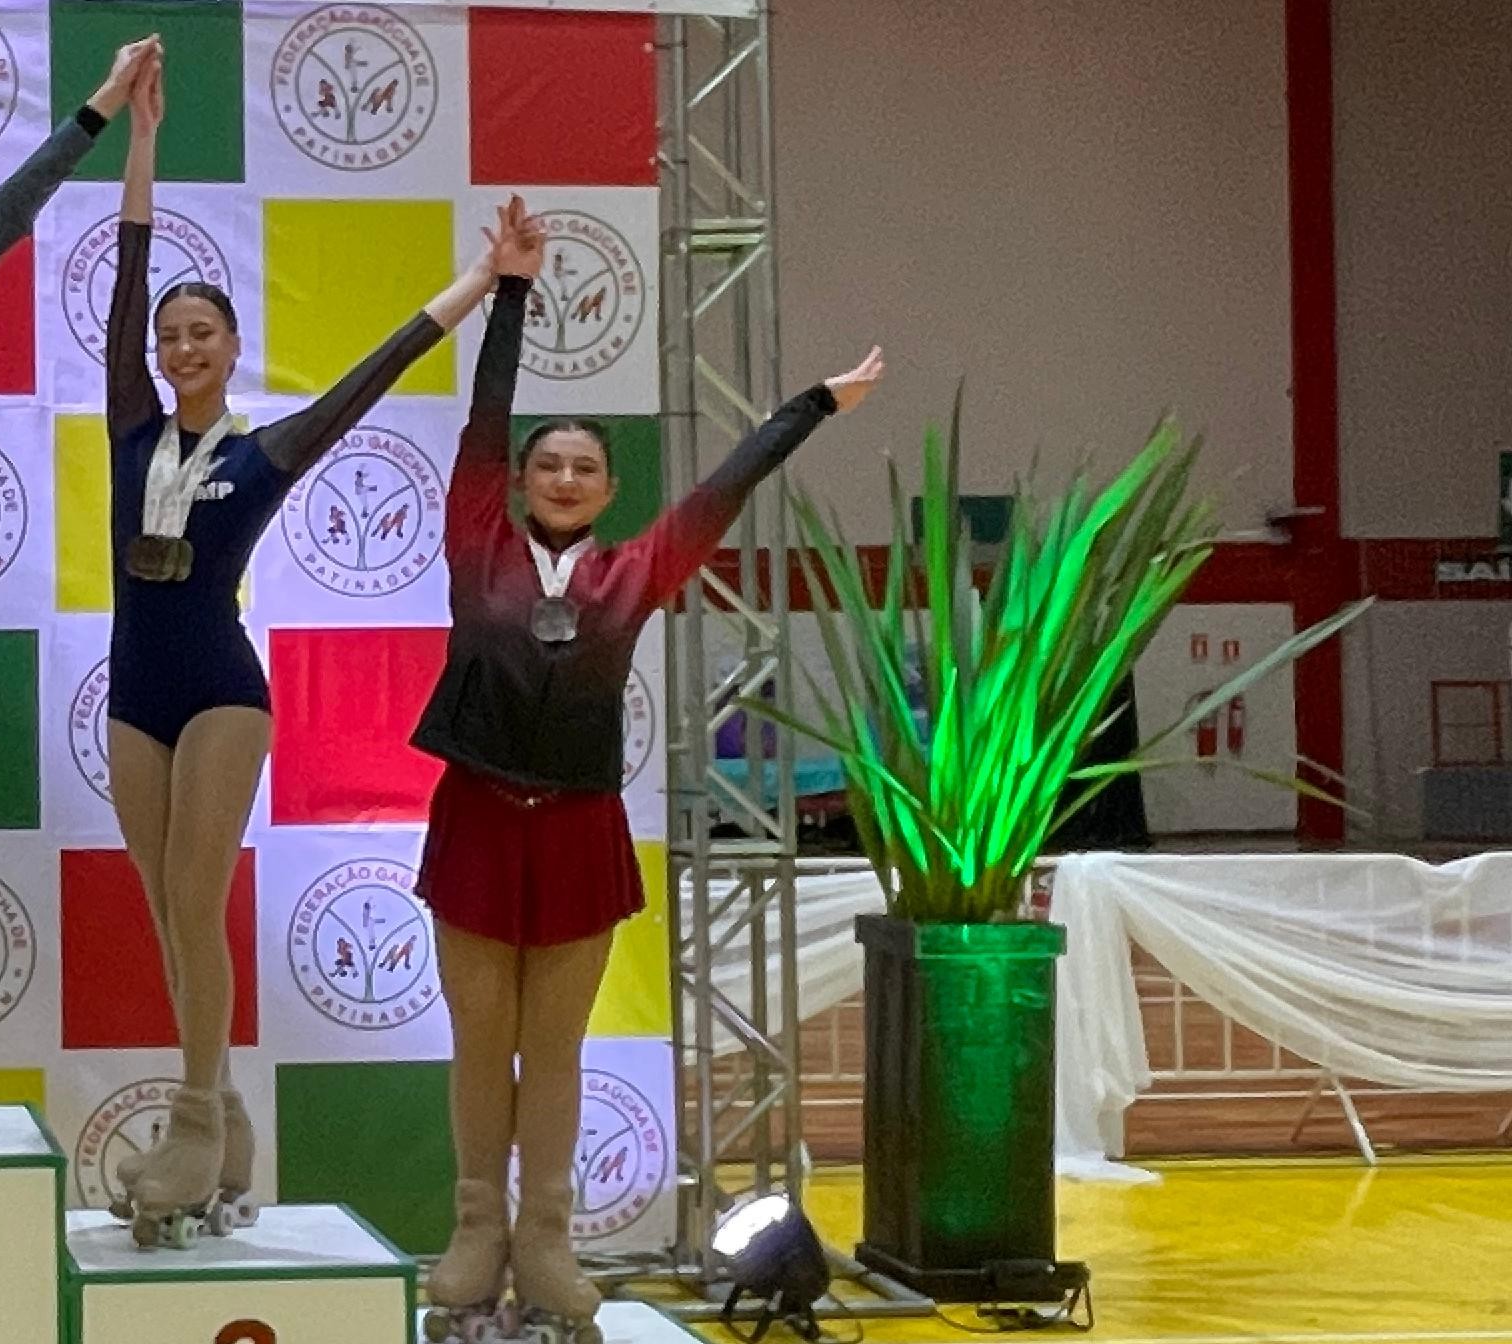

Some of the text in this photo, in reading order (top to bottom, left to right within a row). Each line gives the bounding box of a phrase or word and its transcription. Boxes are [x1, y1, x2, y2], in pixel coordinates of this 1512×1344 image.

[276, 9, 354, 86] FEDERAÇÃO
[293, 126, 416, 164] PATINAGEM
[529, 336, 624, 372] TINAGEM
[304, 553, 428, 592] PATINAGEM
[294, 865, 372, 946] FEDERAÇÃO
[311, 984, 433, 1023] PATINAGEM
[80, 1085, 161, 1166] FEDERAÇÃO
[572, 1194, 646, 1234] NAGEM
